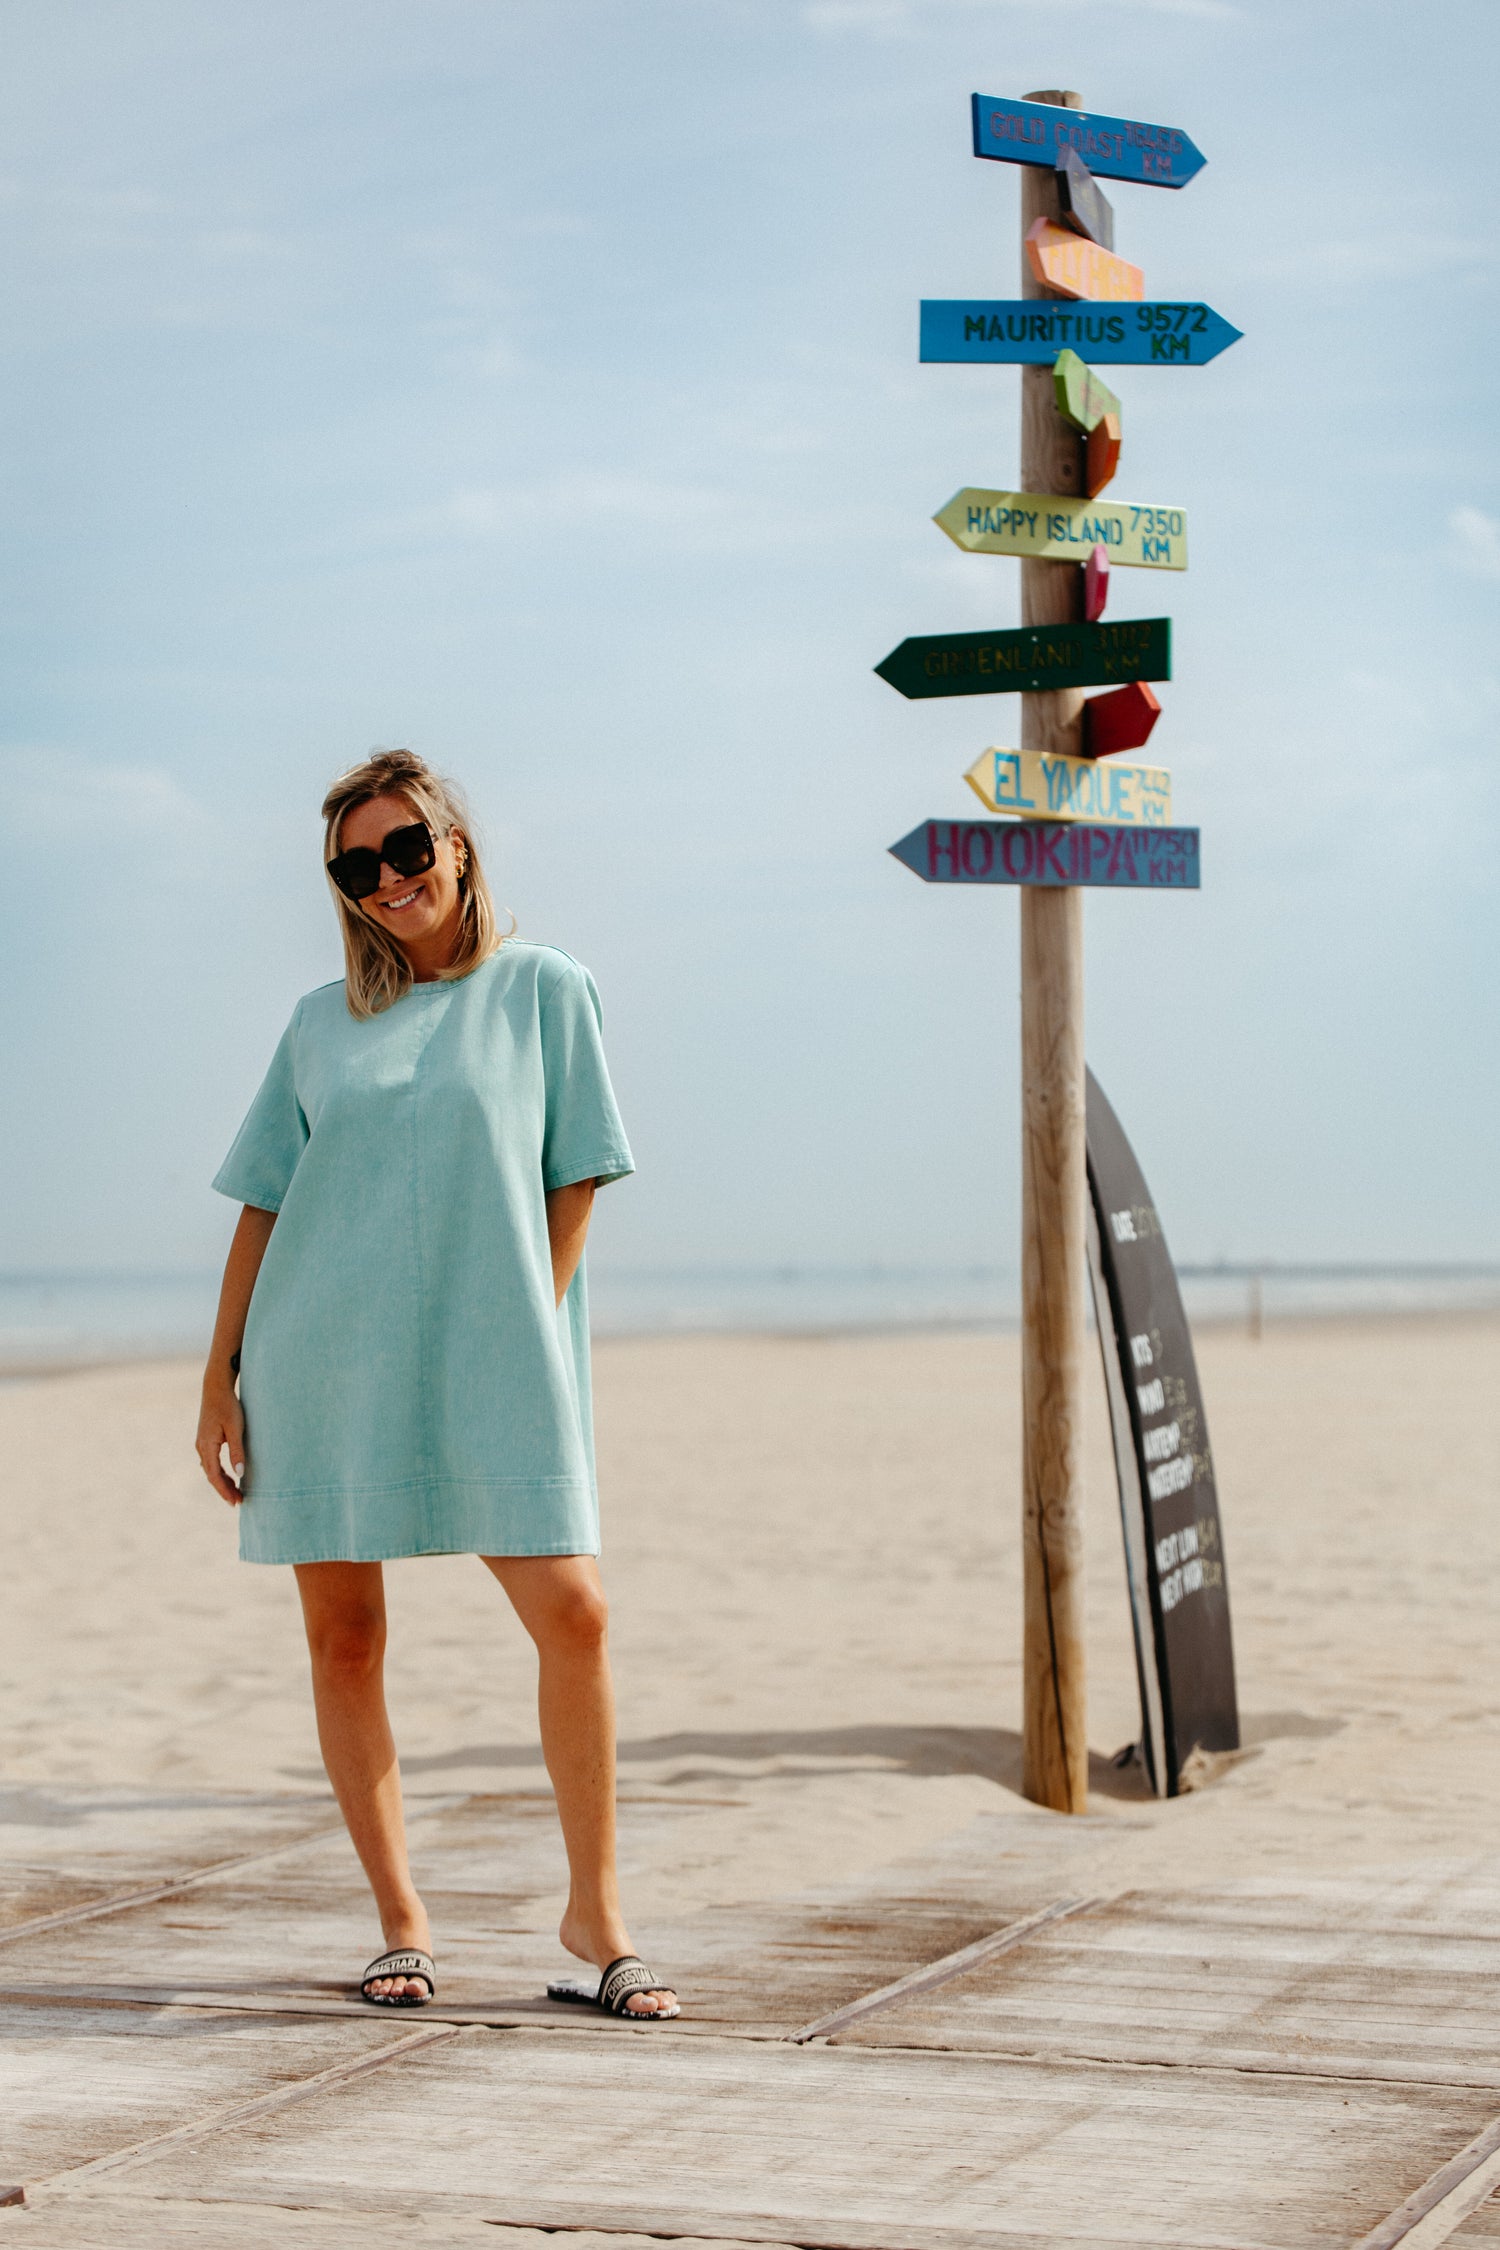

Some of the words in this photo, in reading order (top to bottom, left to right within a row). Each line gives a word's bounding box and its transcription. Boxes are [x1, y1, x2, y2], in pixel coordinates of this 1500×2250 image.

[990, 111, 1046, 146] GOLD
[1053, 121, 1124, 161] COAST
[1142, 151, 1173, 181] KM
[963, 314, 1125, 344] MAURITIUS
[1137, 304, 1208, 333] 9572
[1151, 333, 1191, 360] KM
[967, 506, 1039, 538] HAPPY
[1046, 514, 1124, 546] ISLAND
[1129, 506, 1183, 537] 7350
[1142, 536, 1171, 563] KM
[924, 640, 1084, 678] GROENLAND
[1103, 652, 1143, 678] KM
[994, 751, 1035, 808] EL
[1040, 758, 1134, 820] YAQUE
[1141, 800, 1164, 825] KM
[927, 823, 1138, 881] HOOKIPA
[1148, 858, 1186, 883] KM
[366, 1957, 417, 1977] HRISTIAN
